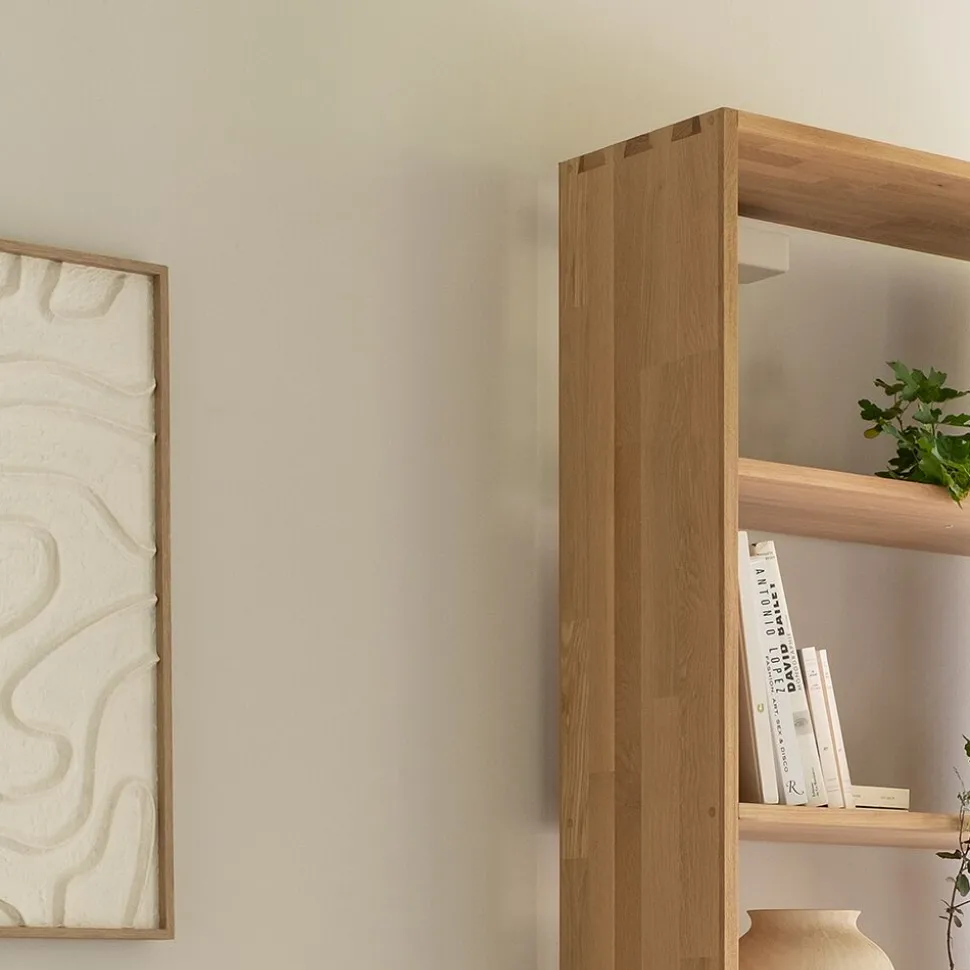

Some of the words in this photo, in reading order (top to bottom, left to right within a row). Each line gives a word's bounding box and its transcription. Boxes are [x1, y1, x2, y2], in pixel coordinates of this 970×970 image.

[755, 569, 776, 636] ANTONIO
[769, 647, 786, 694] LOPEZ
[780, 643, 796, 693] DAVID
[780, 747, 789, 773] DISCO
